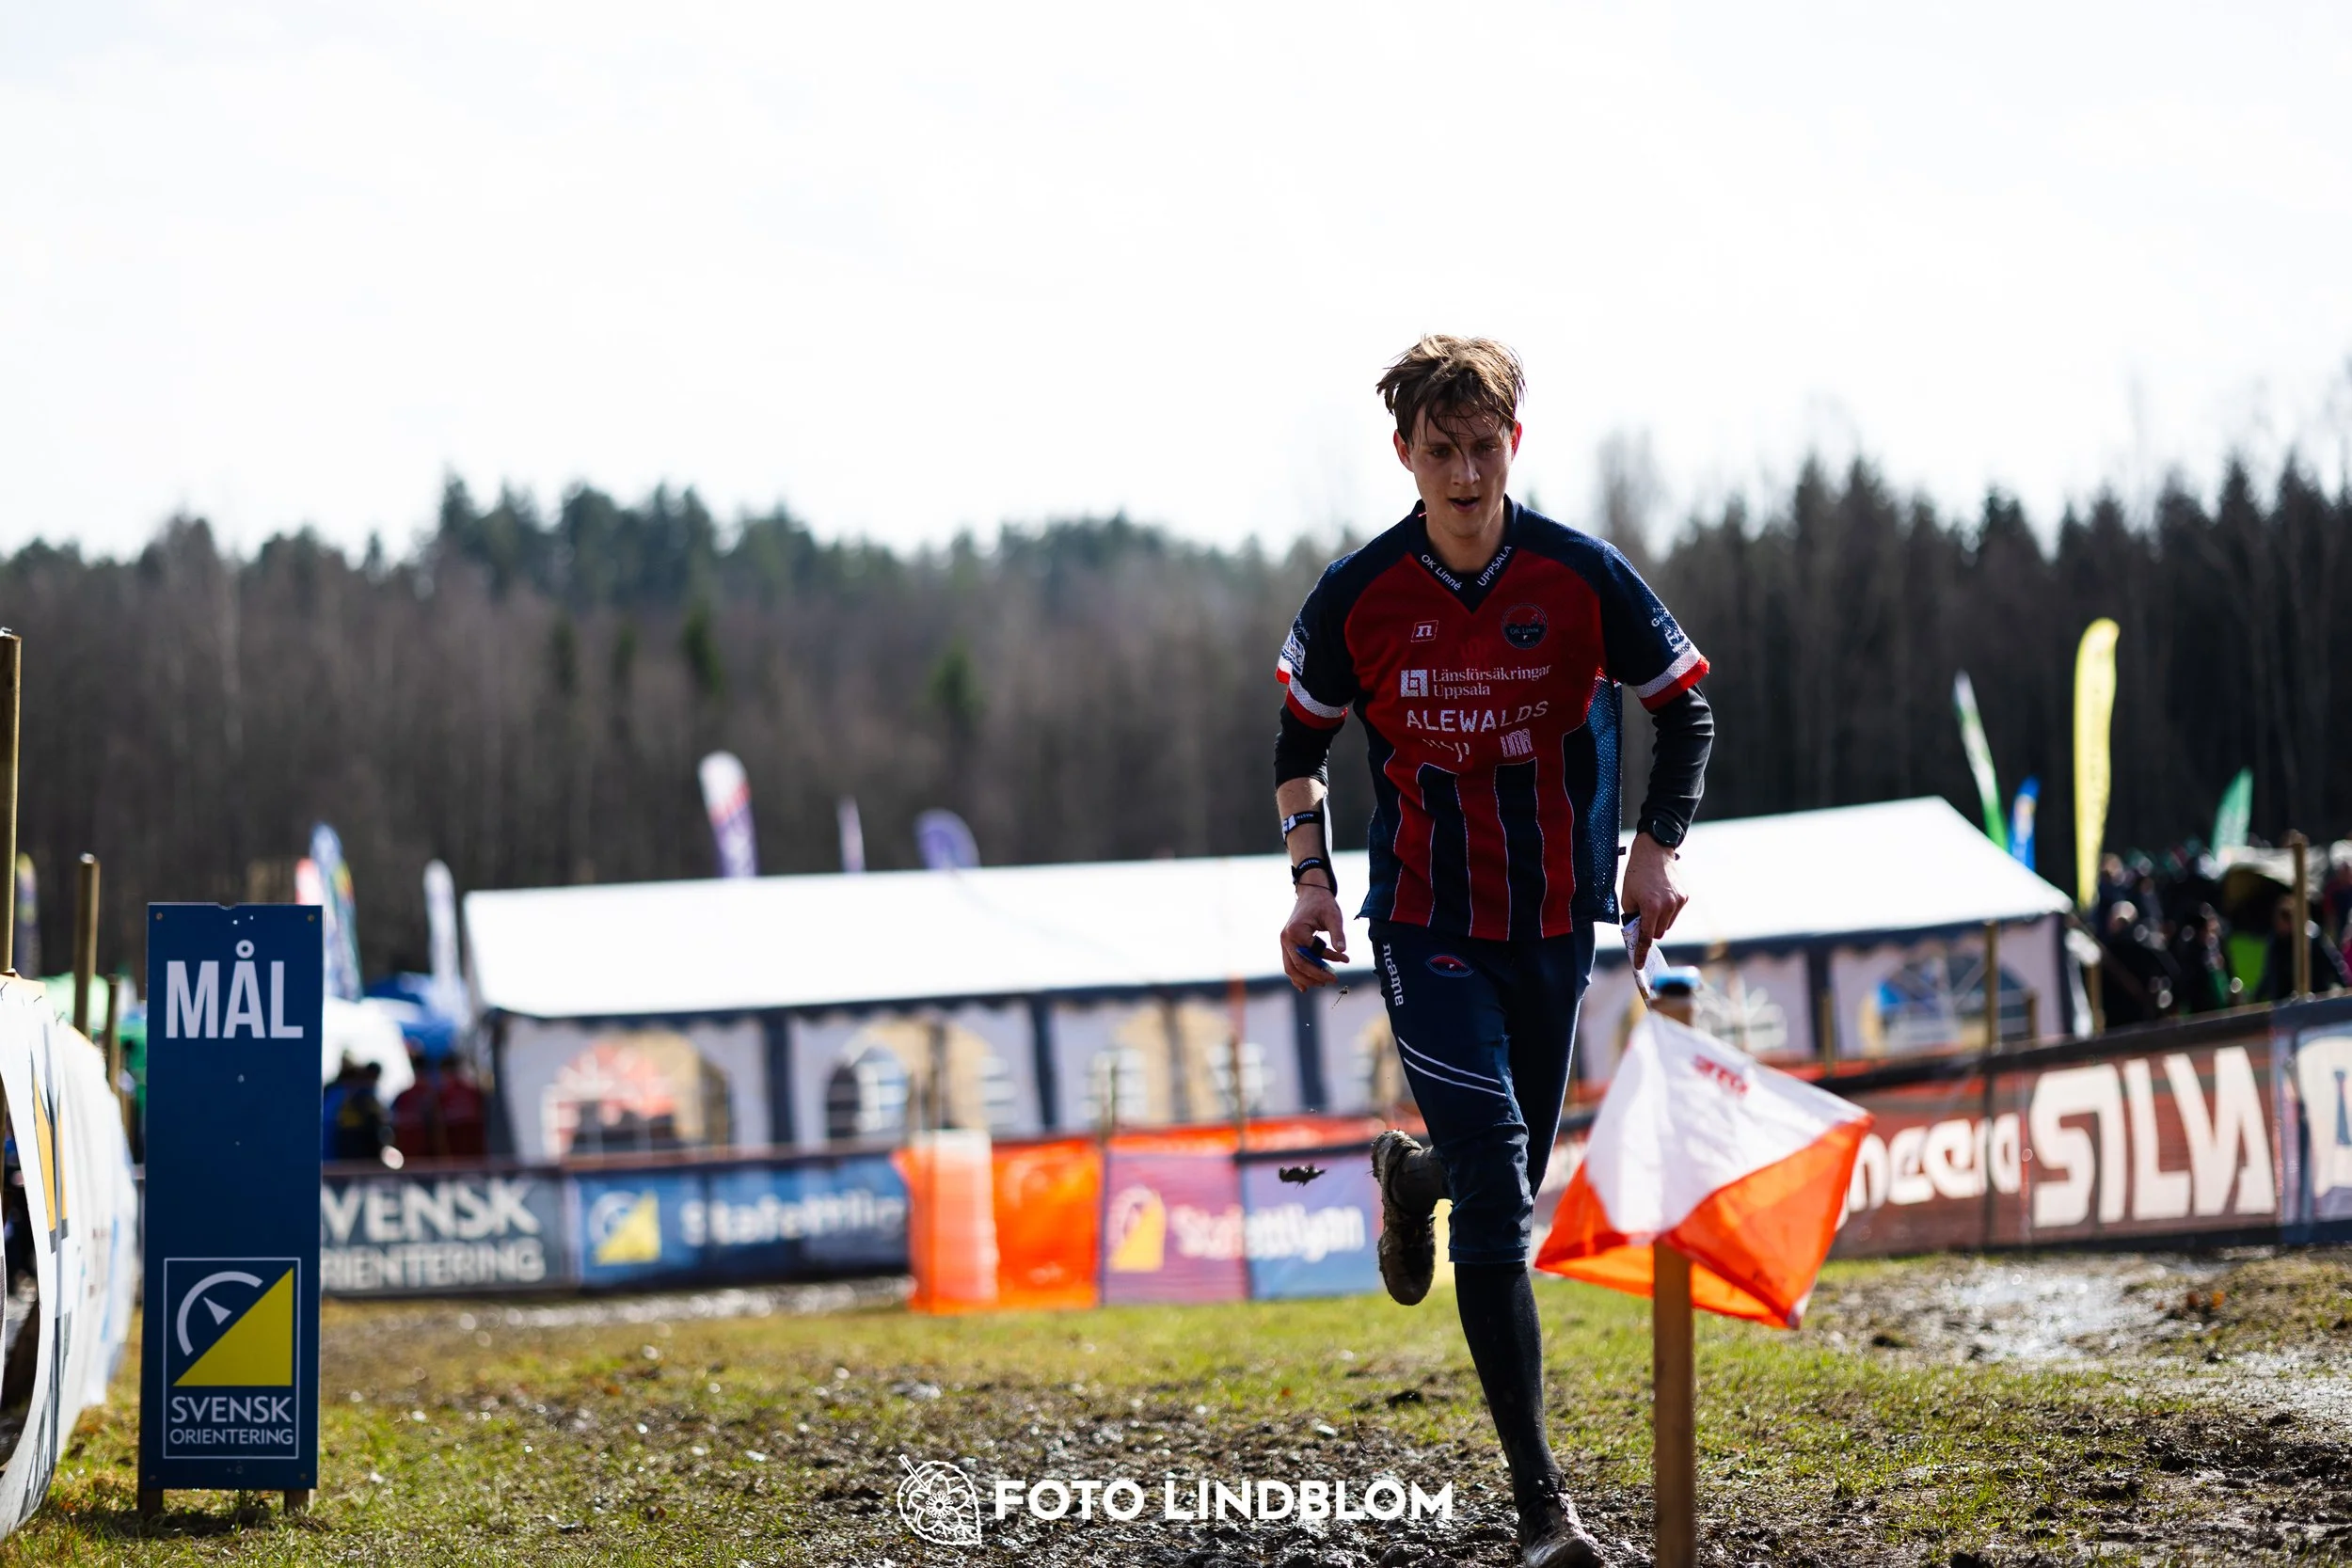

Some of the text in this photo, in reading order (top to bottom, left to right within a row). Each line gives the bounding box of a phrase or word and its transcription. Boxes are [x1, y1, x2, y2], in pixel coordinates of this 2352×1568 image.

[1422, 554, 1462, 590] OK Linné
[1477, 546, 1512, 586] UPPSALA
[1432, 664, 1550, 682] Länsförsäkringar
[1433, 683, 1490, 699] Uppsala
[1406, 701, 1549, 733] ALEWALDS
[166, 939, 304, 1038] MÅL
[321, 1177, 541, 1244] VENSK
[321, 1236, 547, 1291] RIENTERING
[170, 1396, 294, 1423] SVENSK
[169, 1428, 294, 1445] ORIENTERING
